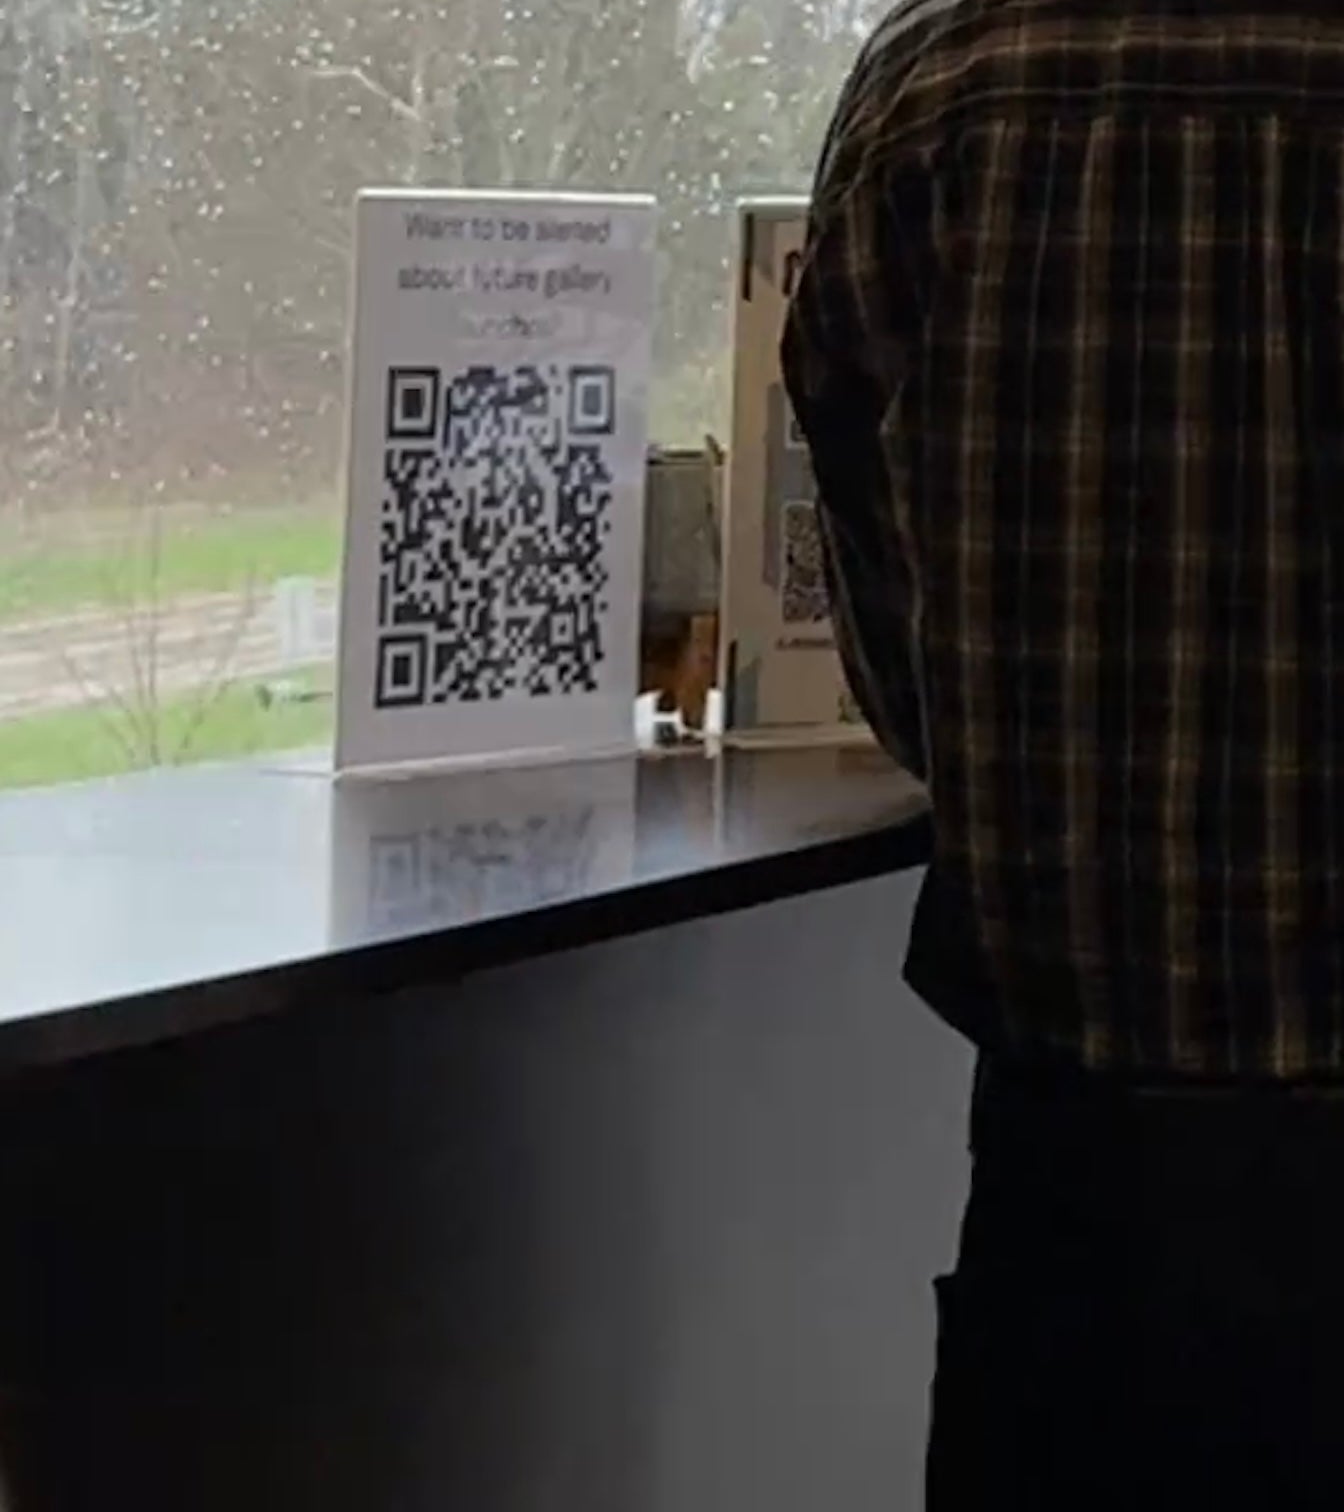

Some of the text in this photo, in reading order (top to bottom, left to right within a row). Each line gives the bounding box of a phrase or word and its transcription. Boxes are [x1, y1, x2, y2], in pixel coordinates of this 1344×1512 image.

[402, 212, 464, 240] Want
[471, 216, 495, 241] to
[501, 215, 531, 242] be
[397, 262, 612, 300] about future gallery
